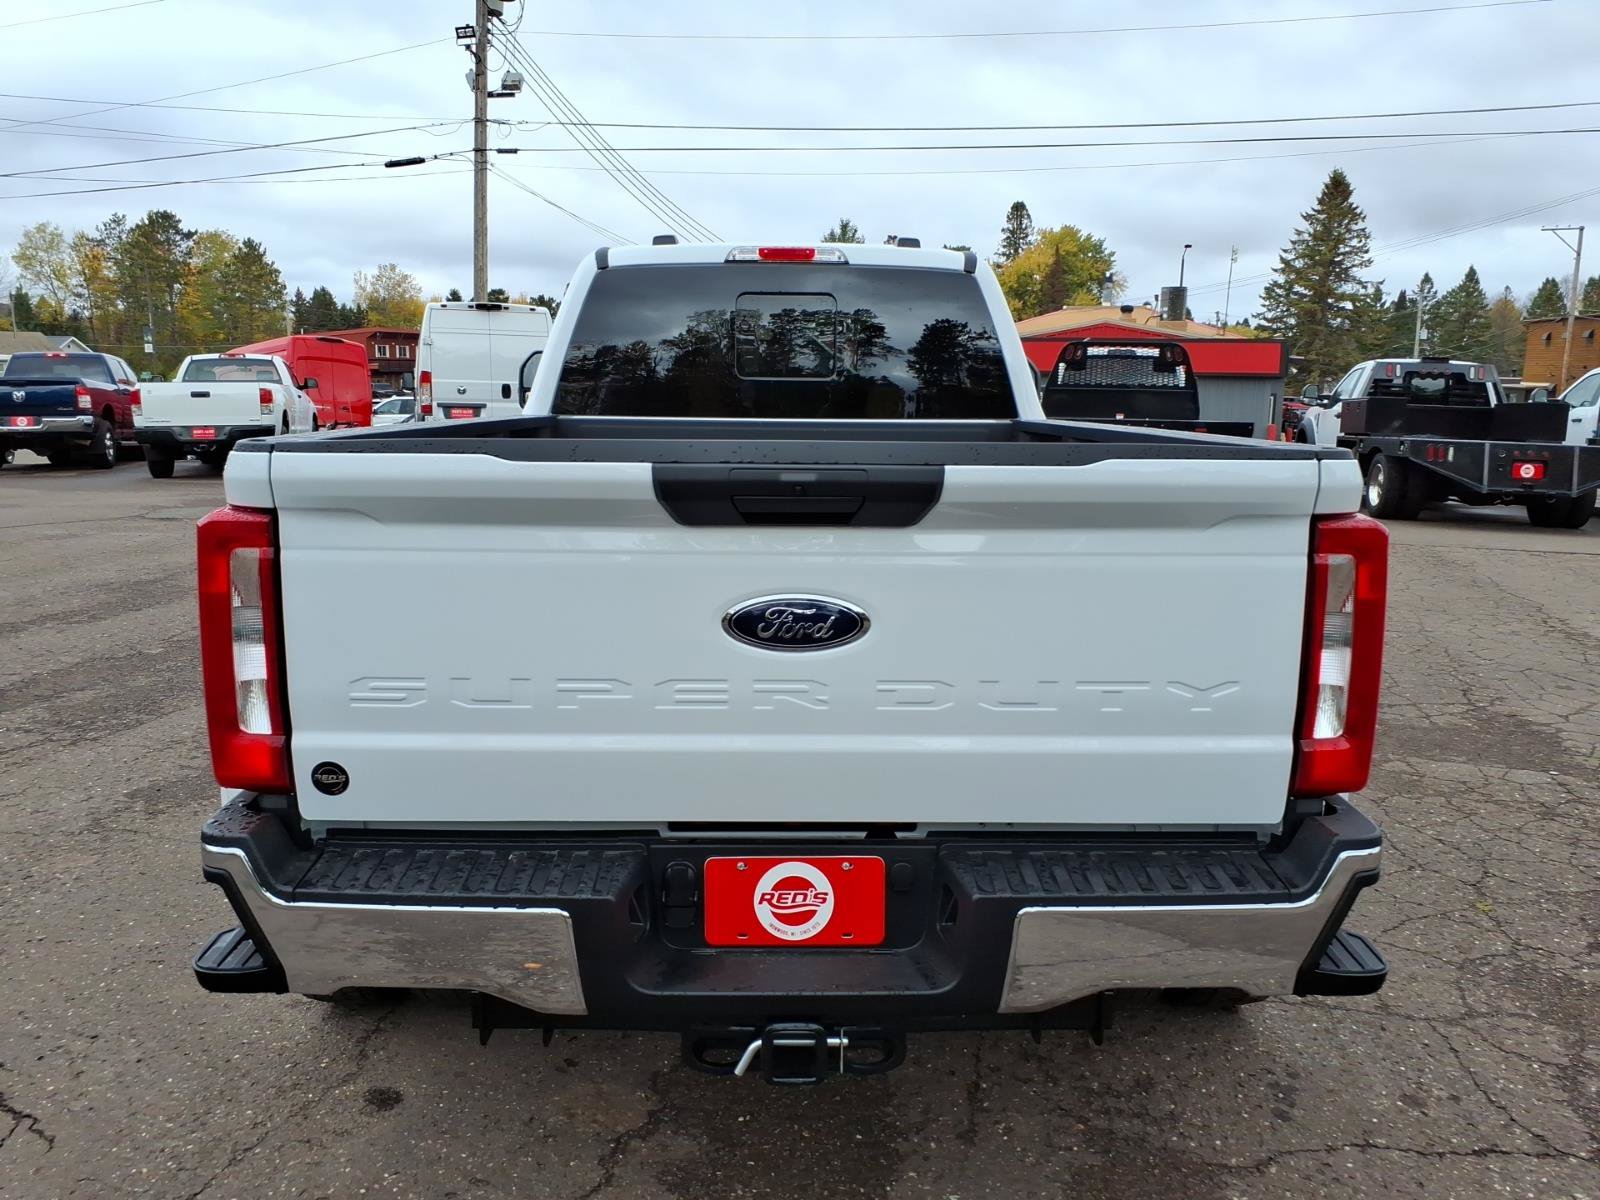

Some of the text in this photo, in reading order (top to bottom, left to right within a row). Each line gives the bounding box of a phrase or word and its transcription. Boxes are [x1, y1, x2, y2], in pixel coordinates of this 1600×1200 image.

[757, 606, 835, 639] Ford
[349, 676, 1241, 712] SUPER DUTY
[758, 889, 828, 905] RED'S
